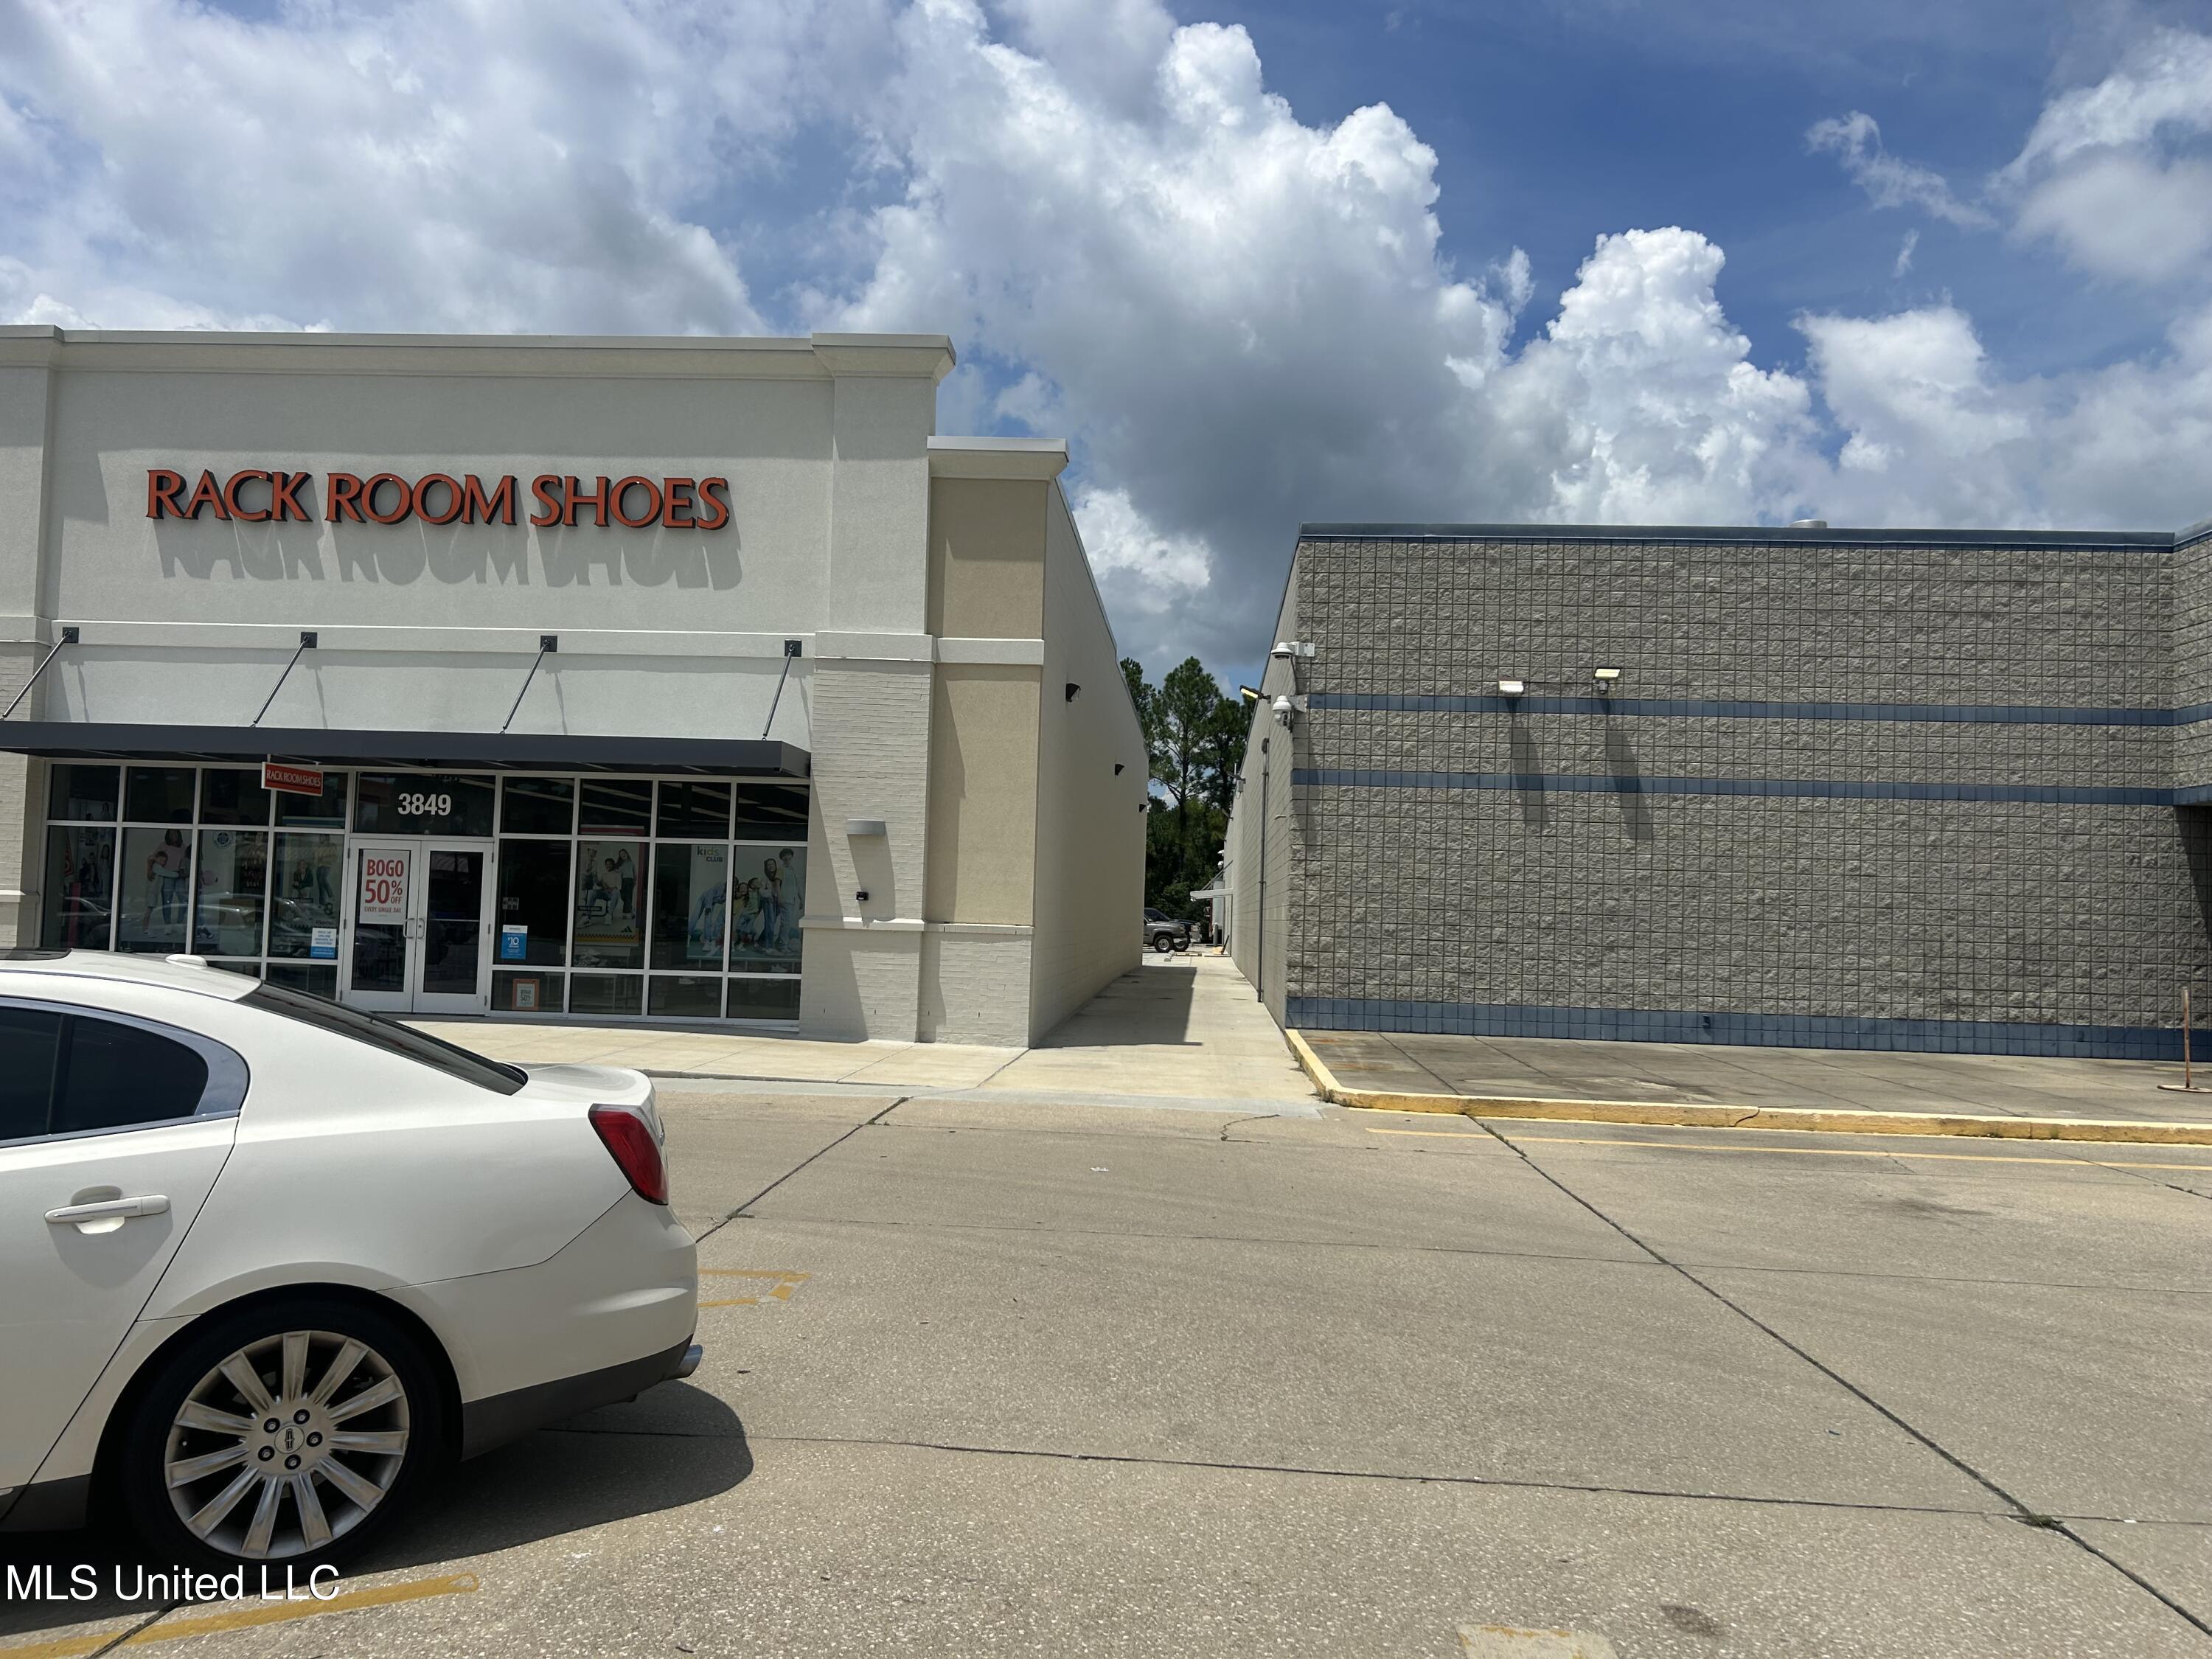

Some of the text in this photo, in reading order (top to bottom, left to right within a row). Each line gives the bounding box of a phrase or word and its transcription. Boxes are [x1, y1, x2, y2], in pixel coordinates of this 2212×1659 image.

[146, 469, 729, 530] RACK ROOM SHOES
[266, 769, 321, 787] RACK ROOM SHOES
[398, 793, 451, 815] 3849
[366, 859, 404, 877] BOGO
[364, 879, 403, 904] 50%
[390, 896, 403, 904] OFF
